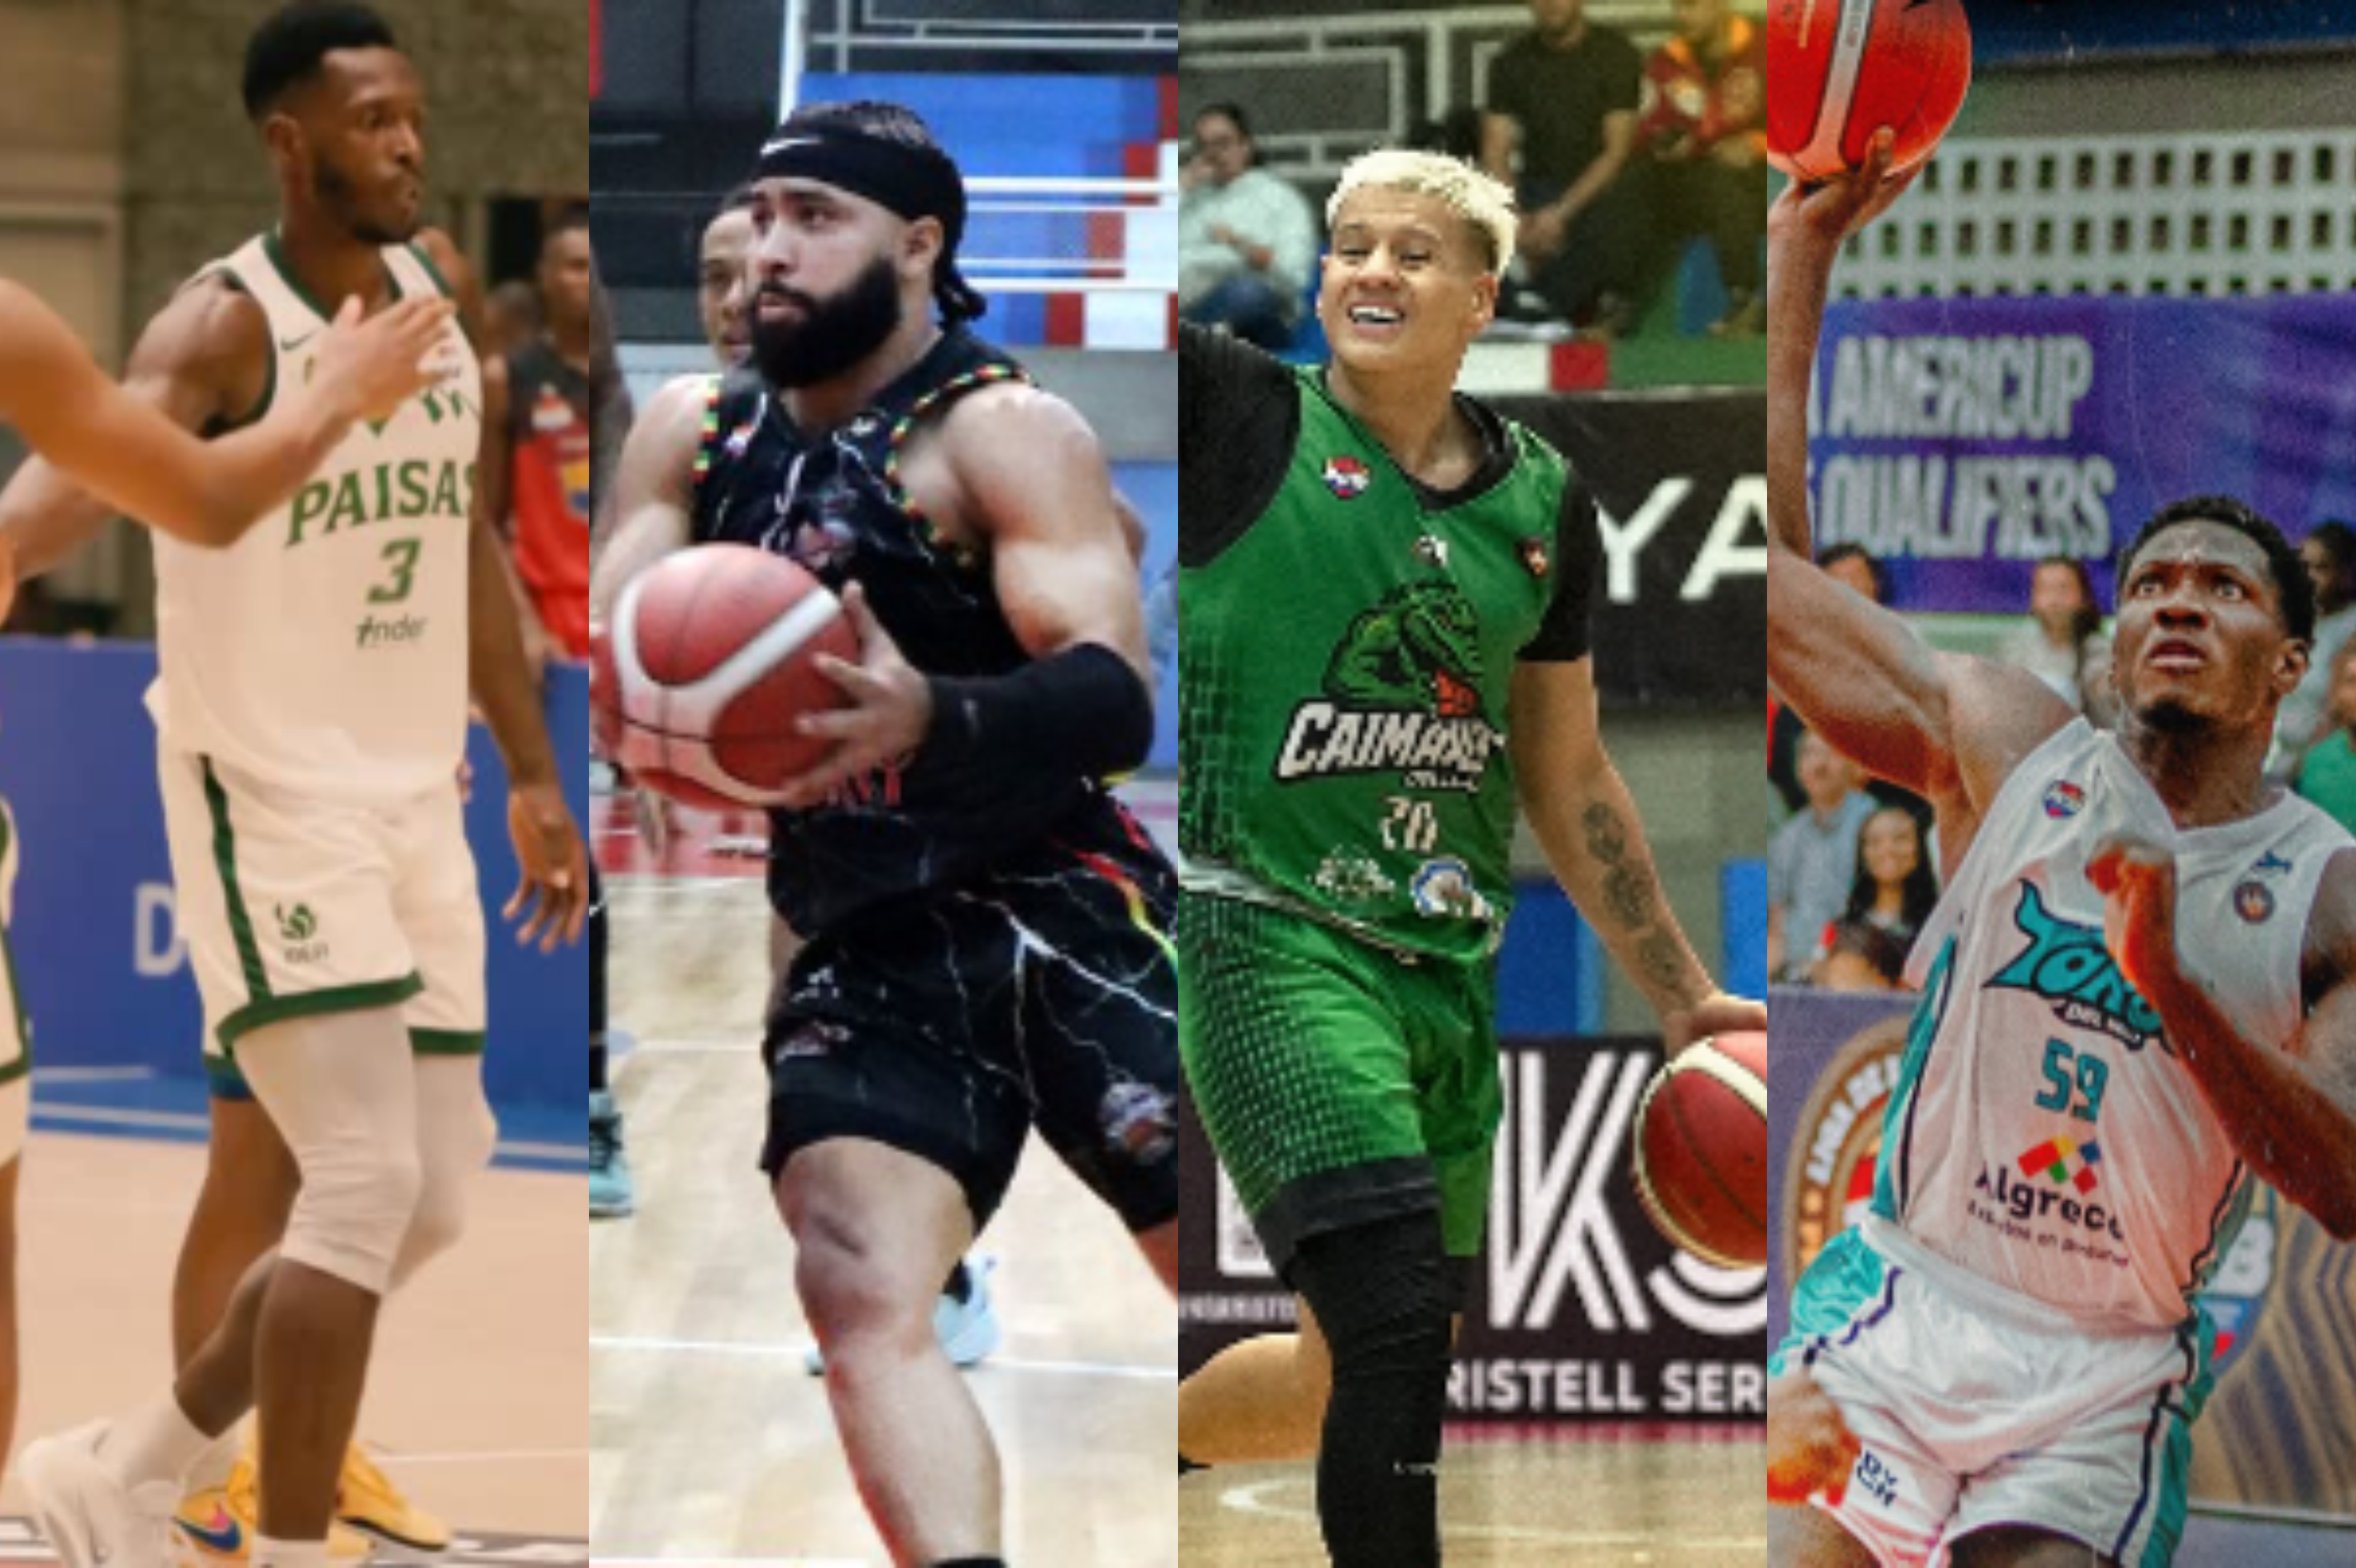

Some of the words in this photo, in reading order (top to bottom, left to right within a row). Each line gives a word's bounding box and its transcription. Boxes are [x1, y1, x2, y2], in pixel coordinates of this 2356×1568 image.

[1828, 334, 2094, 440] AMERICUP
[1595, 475, 1767, 604] YA
[1820, 454, 2117, 559] QUALIFIERS
[366, 537, 421, 606] 3
[2035, 1036, 2109, 1124] 59
[1660, 1360, 1767, 1412] SER
